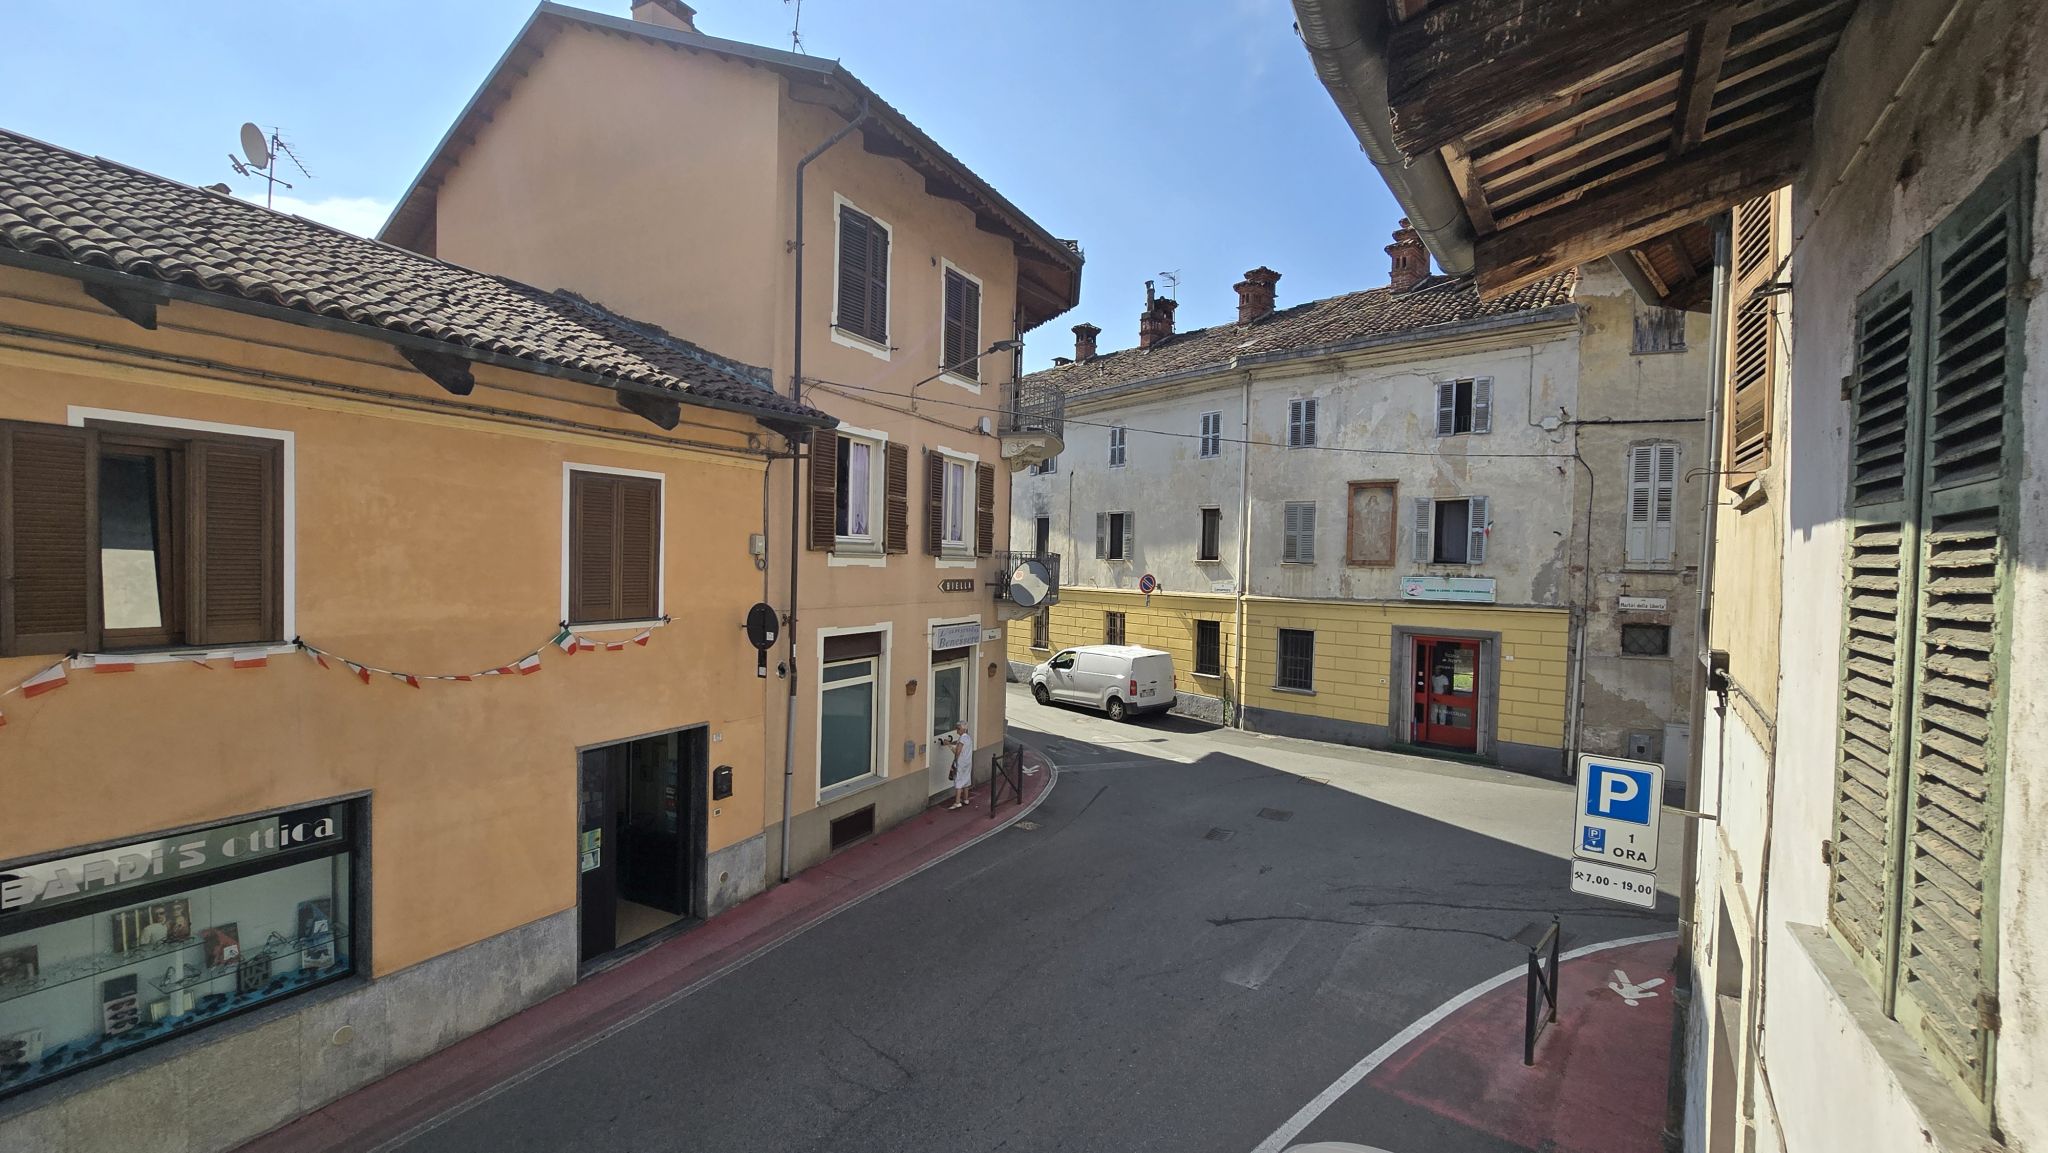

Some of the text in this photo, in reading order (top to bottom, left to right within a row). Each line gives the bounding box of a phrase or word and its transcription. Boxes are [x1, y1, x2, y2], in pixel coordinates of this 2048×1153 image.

[946, 581, 971, 590] BIELLA
[1598, 771, 1639, 814] P
[1590, 829, 1599, 837] P
[1628, 834, 1635, 844] 1
[1612, 847, 1648, 863] ORA
[1586, 873, 1610, 886] 7.00
[1621, 881, 1652, 895] 19.00
